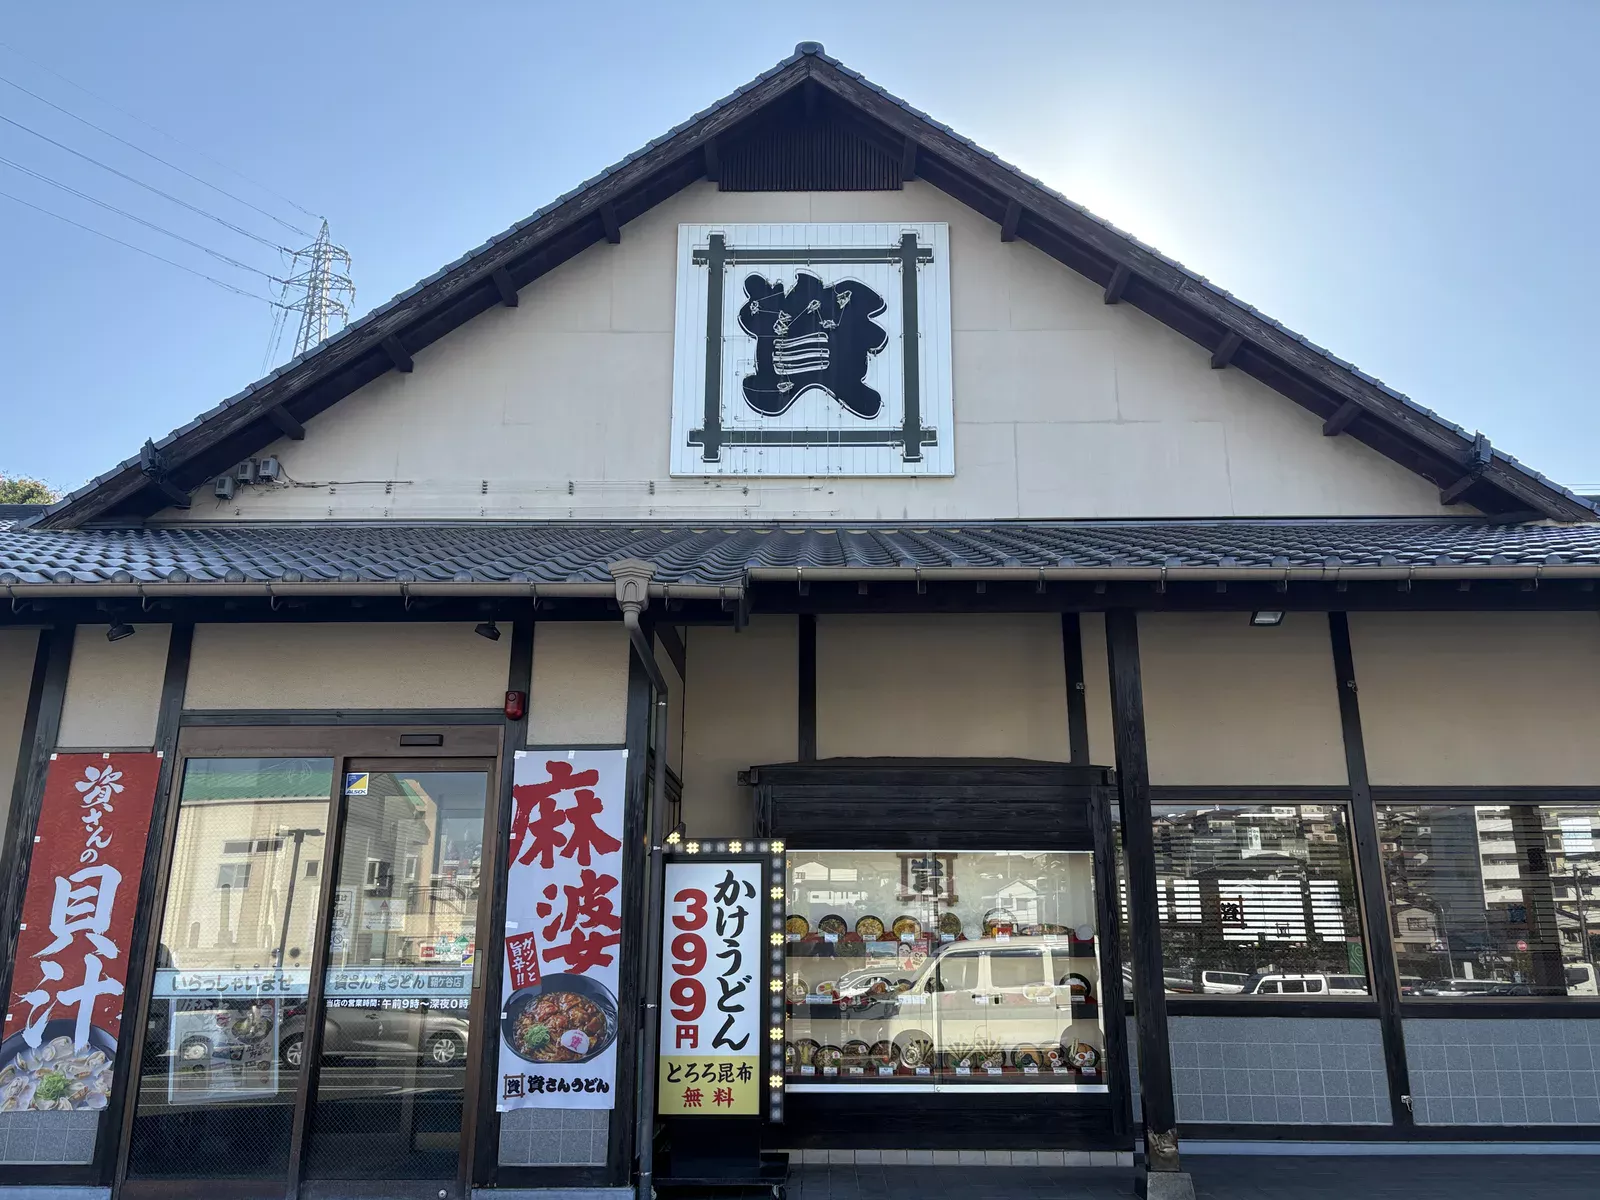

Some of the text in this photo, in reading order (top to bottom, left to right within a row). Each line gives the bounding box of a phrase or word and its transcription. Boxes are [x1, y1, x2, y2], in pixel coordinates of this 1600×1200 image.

[508, 760, 622, 975] 麻婆
[18, 763, 126, 1054] 資さんの 貝汁
[522, 937, 537, 982] ガツンと
[669, 888, 709, 1049] 399円
[712, 869, 757, 1051] かけうどん
[171, 974, 294, 992] いらっしゃいませ
[527, 1075, 610, 1094] 資さんうどん
[667, 1061, 754, 1084] とろろ昆布
[681, 1086, 735, 1108] 無料
